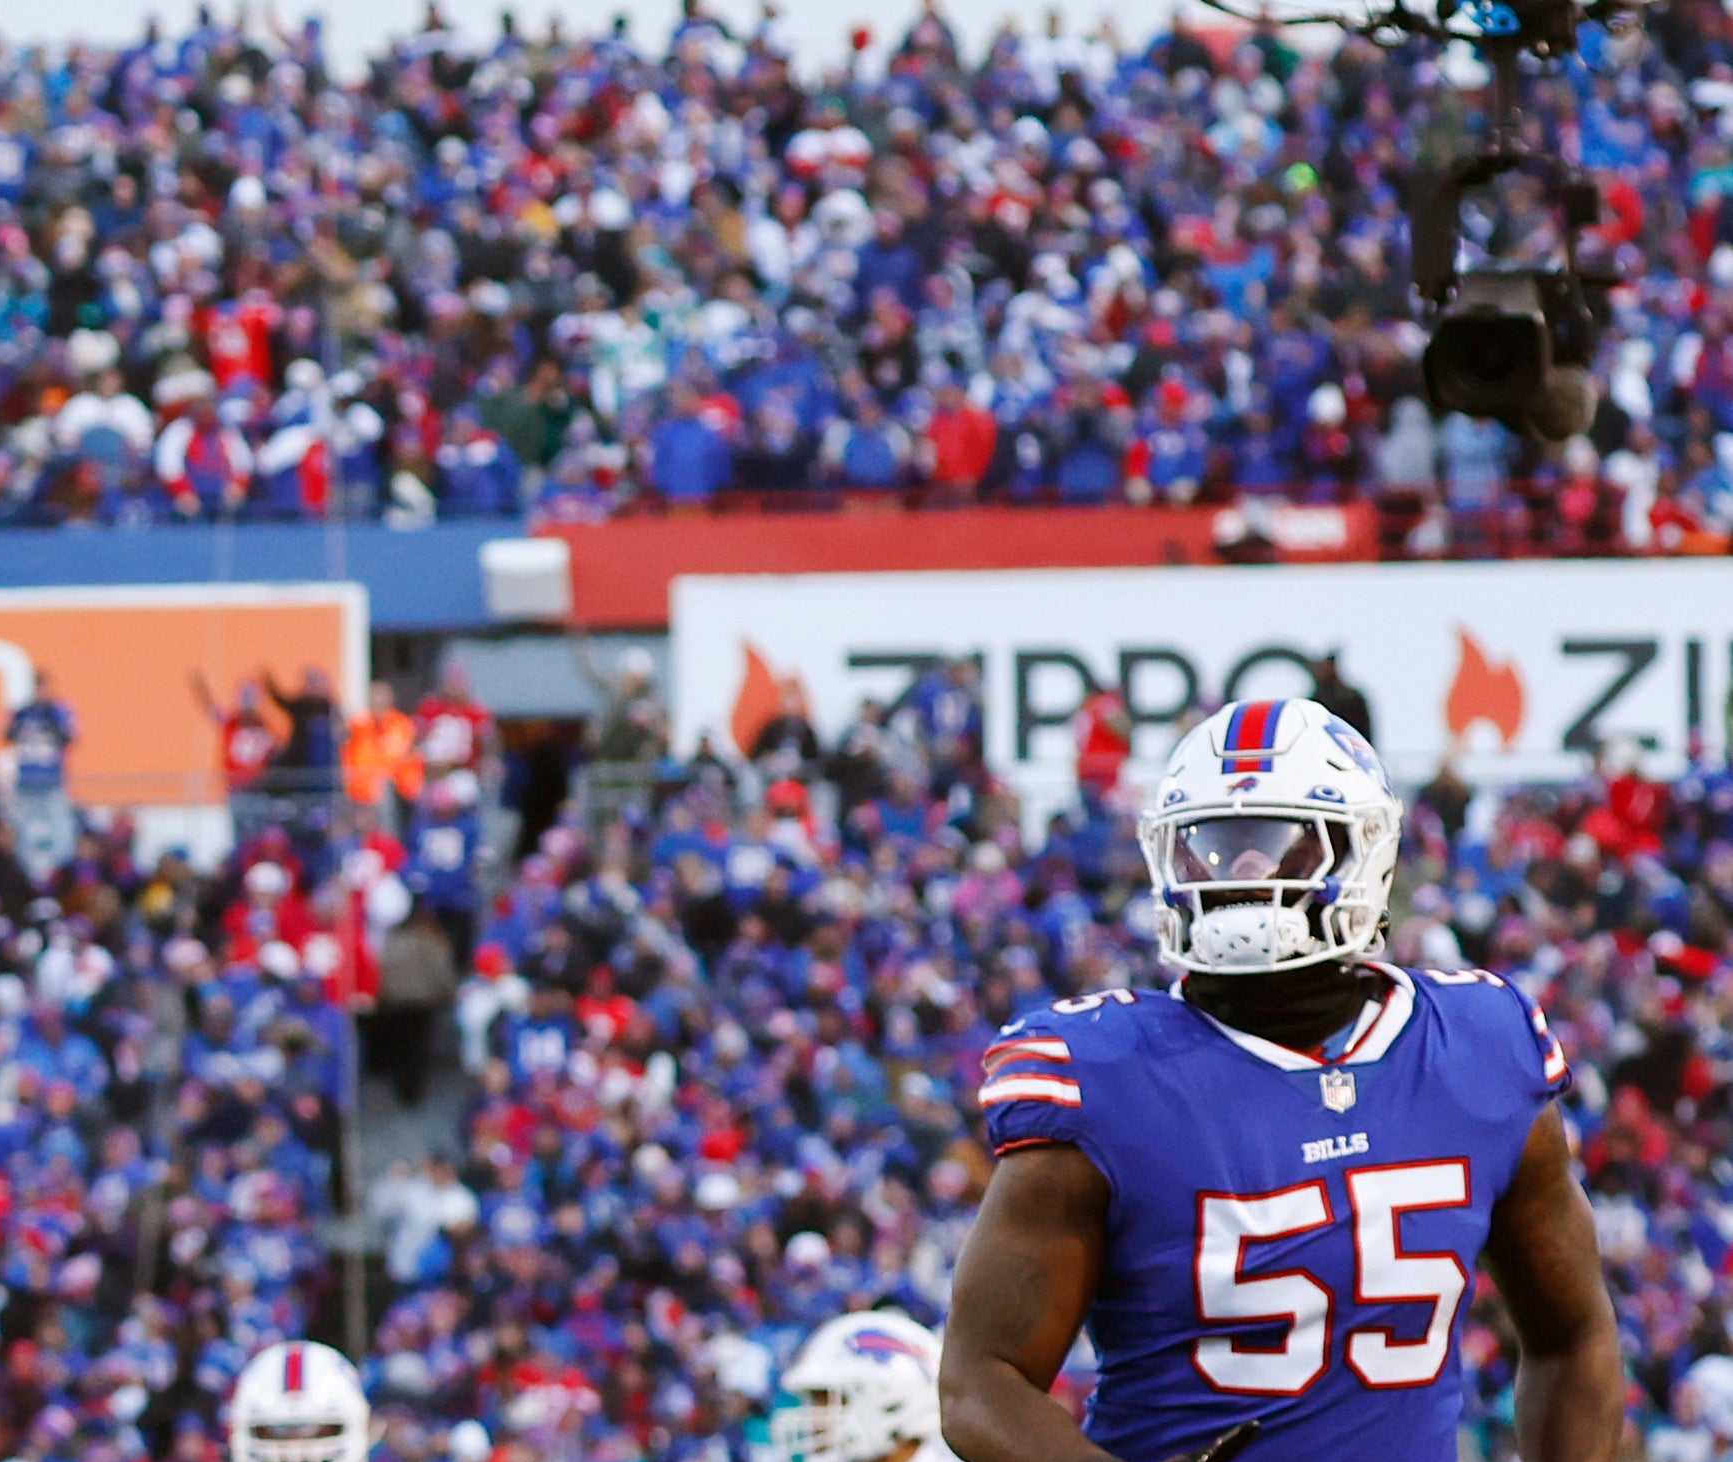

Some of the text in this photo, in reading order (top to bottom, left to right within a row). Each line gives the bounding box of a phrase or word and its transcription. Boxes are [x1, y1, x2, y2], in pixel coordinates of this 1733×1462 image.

[847, 647, 1333, 762] ZPP
[1300, 1131, 1370, 1165] BILLS
[1189, 1156, 1472, 1398] 55
